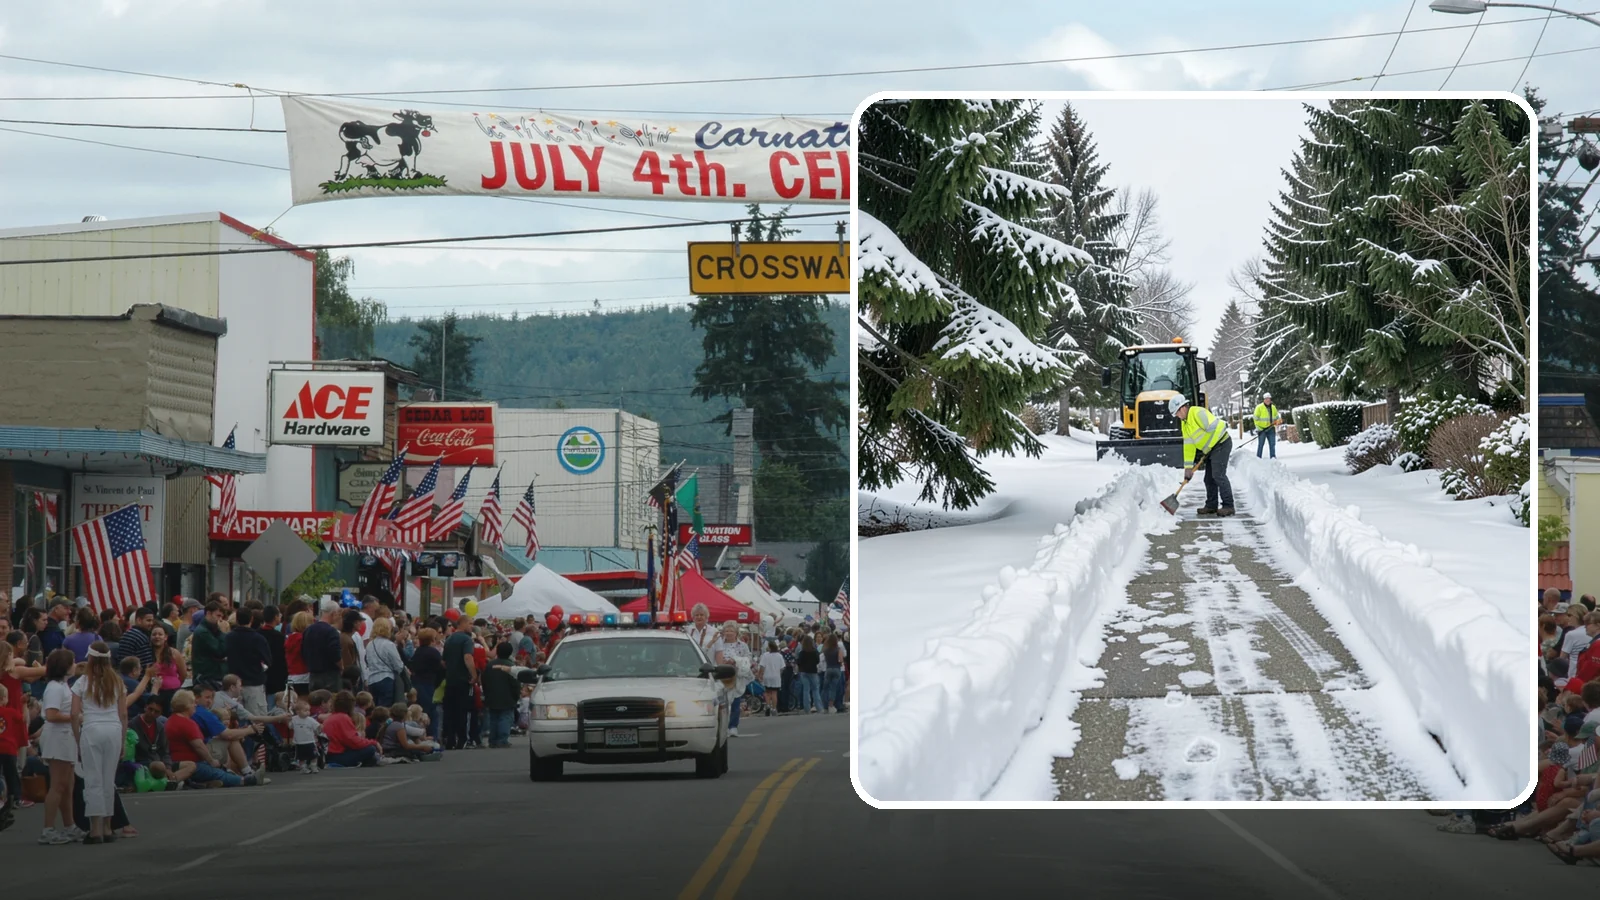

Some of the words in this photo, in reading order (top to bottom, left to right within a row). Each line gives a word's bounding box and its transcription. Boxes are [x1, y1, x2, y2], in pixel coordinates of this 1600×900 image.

[481, 141, 605, 192] JULY
[632, 151, 746, 198] 4th.
[697, 254, 850, 280] CROSSWA
[283, 380, 373, 420] ACE
[405, 409, 453, 422] CEDAR
[461, 409, 485, 422] LOG
[283, 421, 371, 437] Hardware
[416, 428, 477, 447] Coca-Cola
[353, 467, 386, 481] Simpl
[95, 486, 124, 495] Vincent
[126, 487, 136, 495] de
[137, 487, 155, 496] Paul
[80, 503, 154, 522] THRT
[212, 516, 331, 536] HARDARE
[687, 526, 741, 535] CRNATION
[699, 535, 730, 544] GLASS
